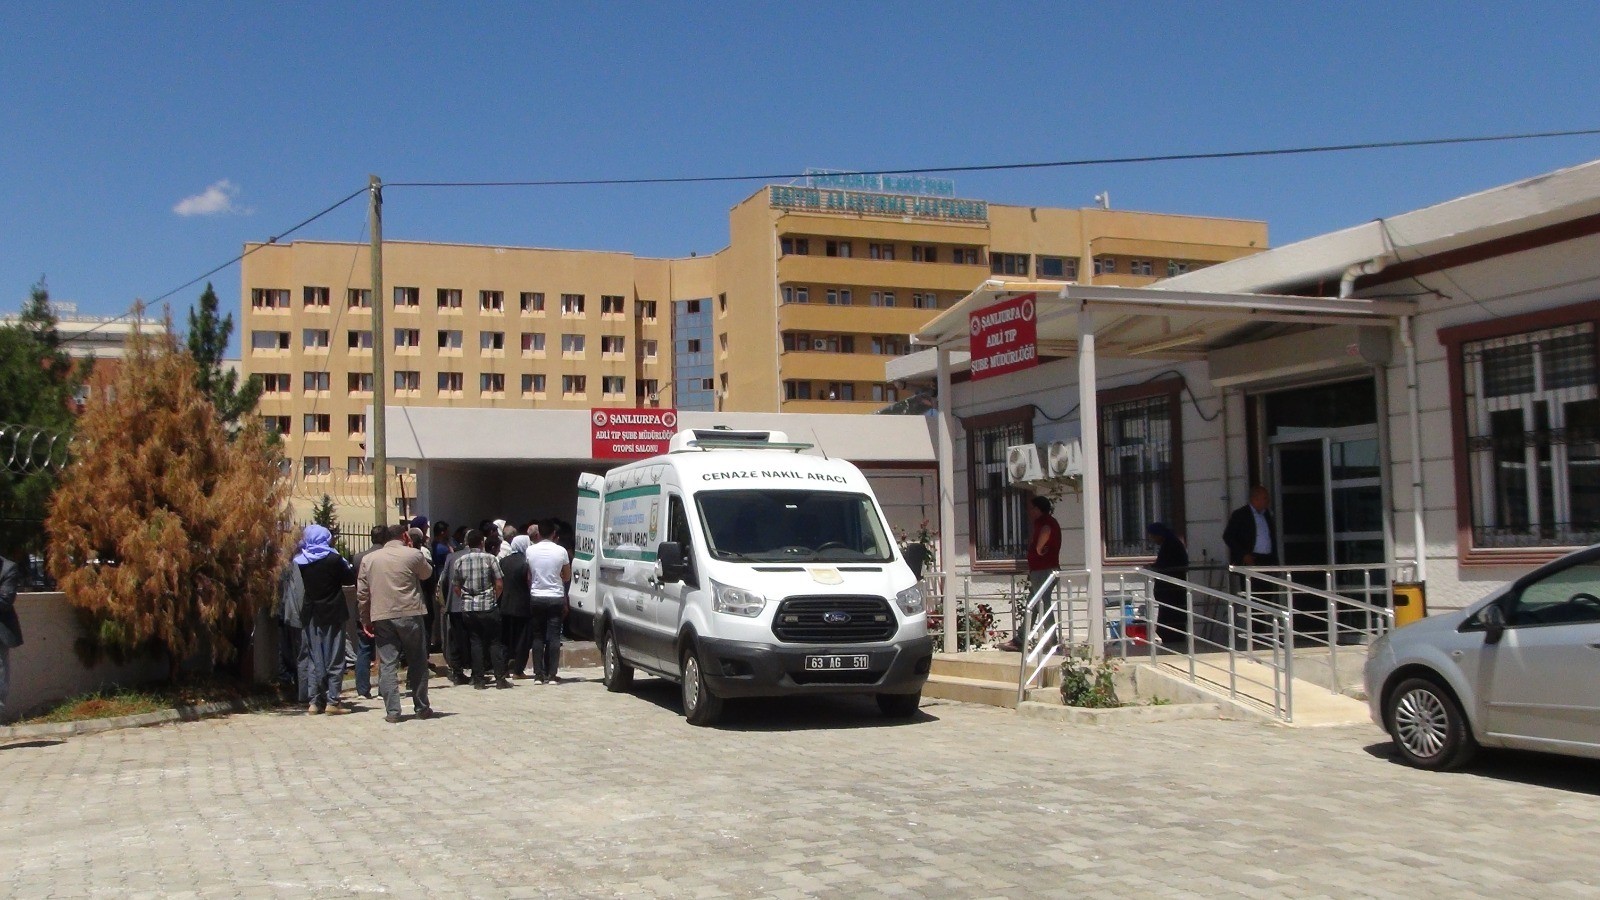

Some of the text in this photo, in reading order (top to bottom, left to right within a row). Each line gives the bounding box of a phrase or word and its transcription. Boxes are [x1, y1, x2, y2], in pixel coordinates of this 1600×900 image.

[980, 306, 1021, 331] ŞANLIURFA
[986, 328, 1017, 348] ADLİ TIP
[971, 343, 1035, 376] ŞUBE MÜDÜRLÜĞÜ
[609, 414, 661, 425] ŞANLIURFA
[596, 429, 610, 440] ADLİ
[611, 430, 621, 440] TIP
[621, 430, 638, 441] ŞUBE
[612, 443, 658, 453] OTOPSİ SALONU
[702, 469, 848, 485] CENAZE NAKİL ARACI
[634, 532, 648, 548] ARACI
[581, 568, 591, 581] ALO
[811, 656, 867, 669] 63 AG 511
